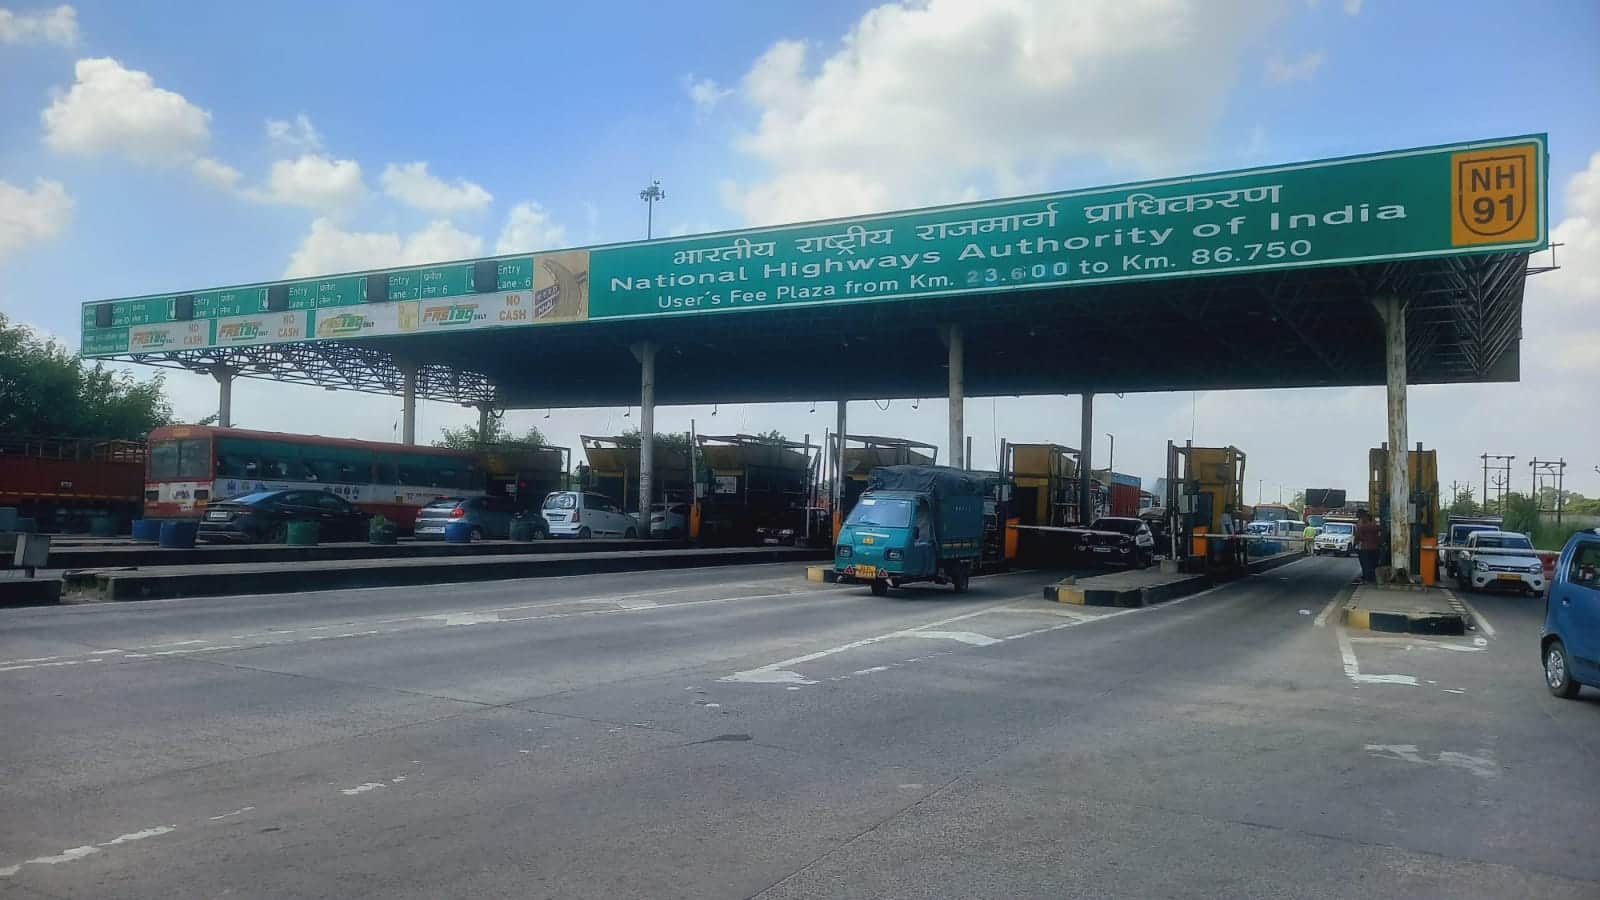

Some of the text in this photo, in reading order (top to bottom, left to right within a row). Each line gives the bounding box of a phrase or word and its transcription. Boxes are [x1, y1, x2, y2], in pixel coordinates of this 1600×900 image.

[1471, 164, 1515, 192] NH
[1472, 194, 1514, 224] 91
[673, 185, 1283, 265] भारतीय राष्ट्रीय राजमार्ग प्राधिकरण
[610, 203, 1408, 292] National Highways Authority of India
[497, 264, 521, 275] Entry
[730, 289, 767, 303] Fee
[776, 284, 836, 300] Plaza
[844, 279, 899, 294] from
[910, 273, 954, 289] Km.
[1079, 259, 1109, 275] to
[1122, 254, 1176, 271] Km.
[1191, 239, 1312, 265] 86.750
[389, 276, 410, 287] Entry
[497, 278, 517, 289] Lane
[288, 287, 309, 297] Entry
[505, 295, 521, 306] NO
[500, 309, 527, 321] CASH
